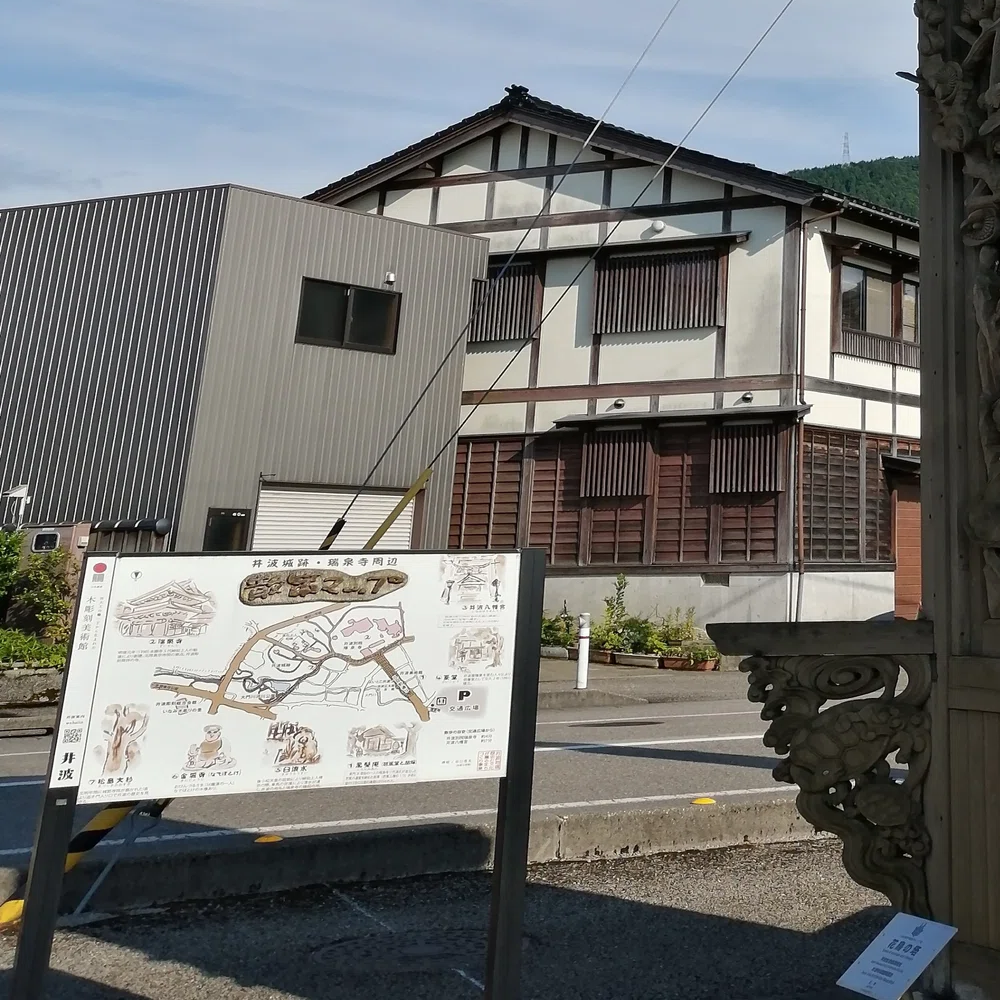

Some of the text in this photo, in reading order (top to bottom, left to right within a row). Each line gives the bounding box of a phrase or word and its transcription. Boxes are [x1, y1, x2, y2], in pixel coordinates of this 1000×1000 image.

[251, 556, 399, 568] 井波城跡・瑞泉寺周辺
[243, 573, 405, 601] 散策マップ
[78, 595, 96, 651] 木彫刻美術館
[458, 690, 471, 701] P
[57, 752, 76, 781] 井波
